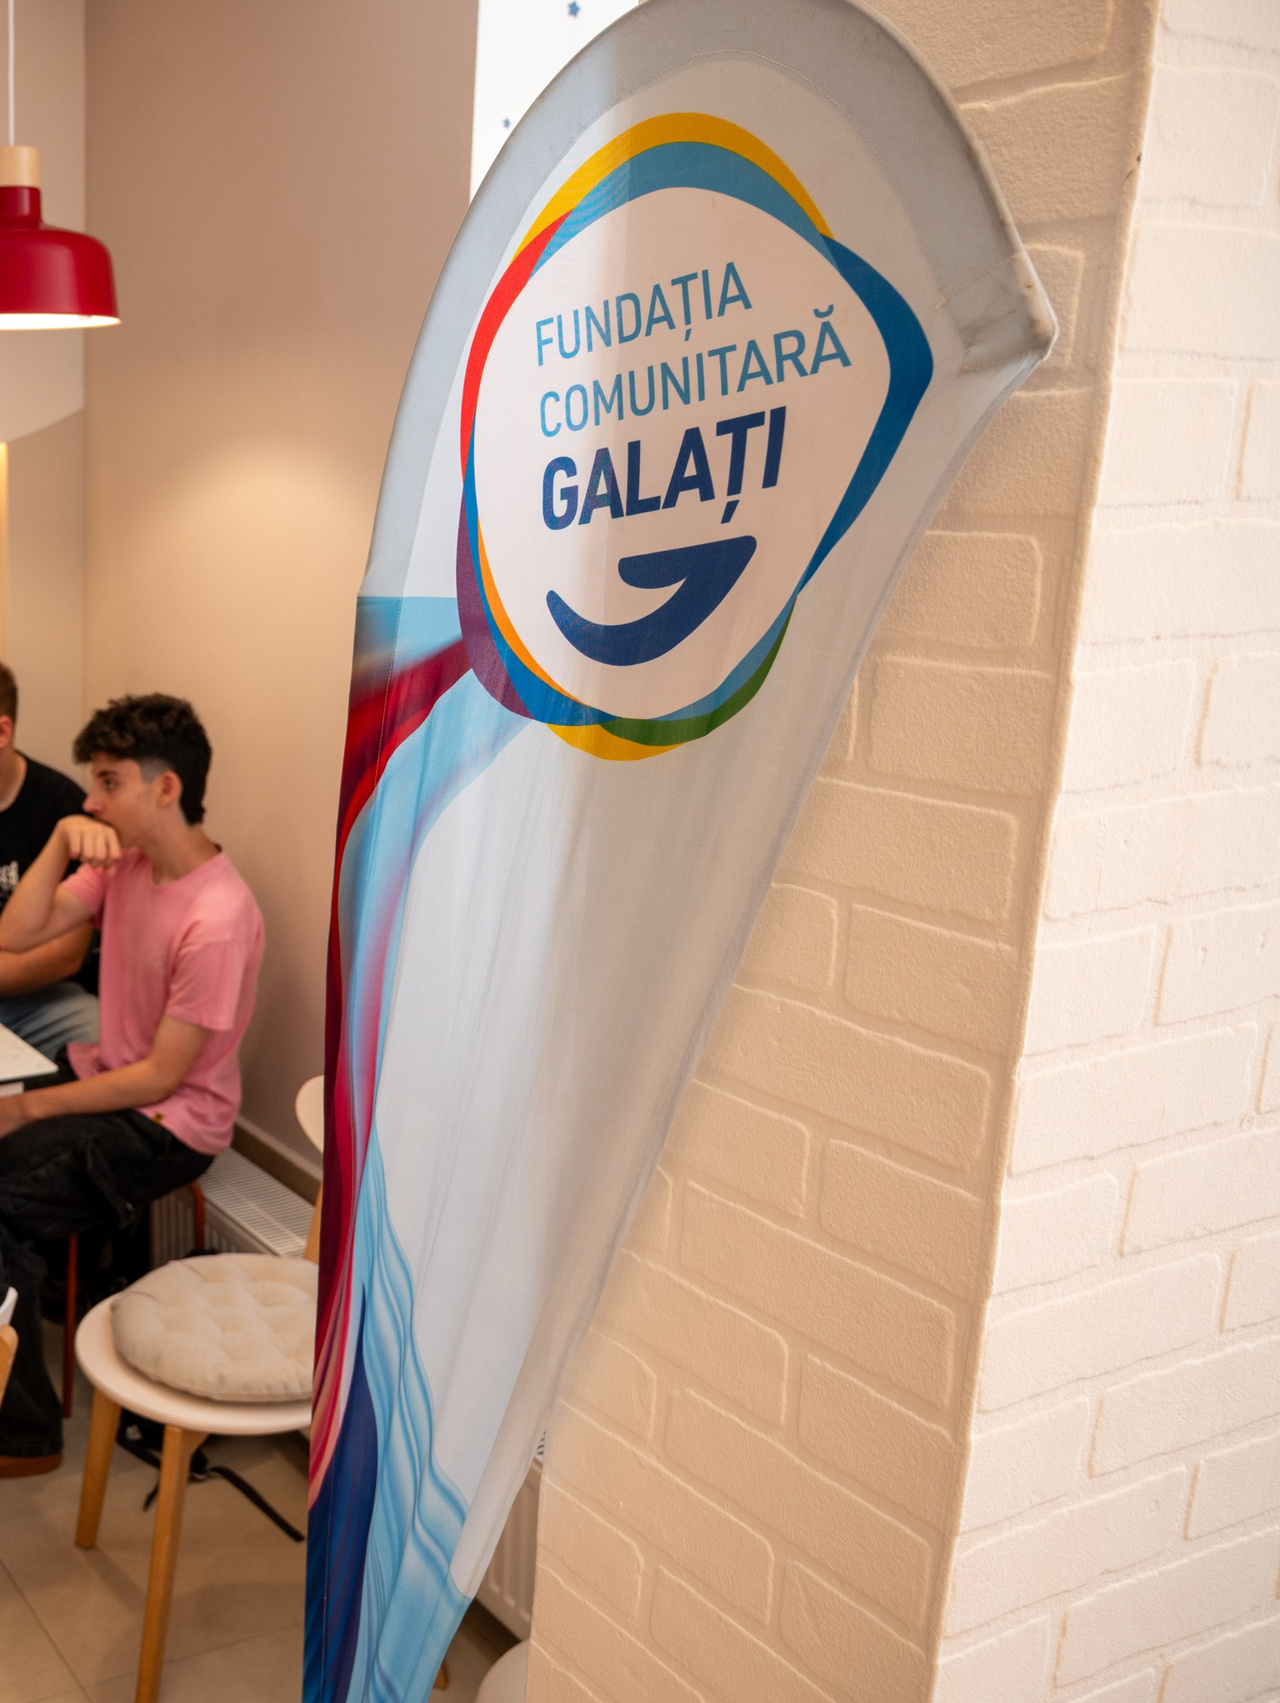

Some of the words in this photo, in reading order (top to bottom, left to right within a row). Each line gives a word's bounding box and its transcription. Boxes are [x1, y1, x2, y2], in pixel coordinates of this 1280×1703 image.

[536, 262, 752, 366] FUNDAȚIA
[540, 305, 851, 437] COMUNITARĂ
[542, 406, 786, 530] GALAȚI
